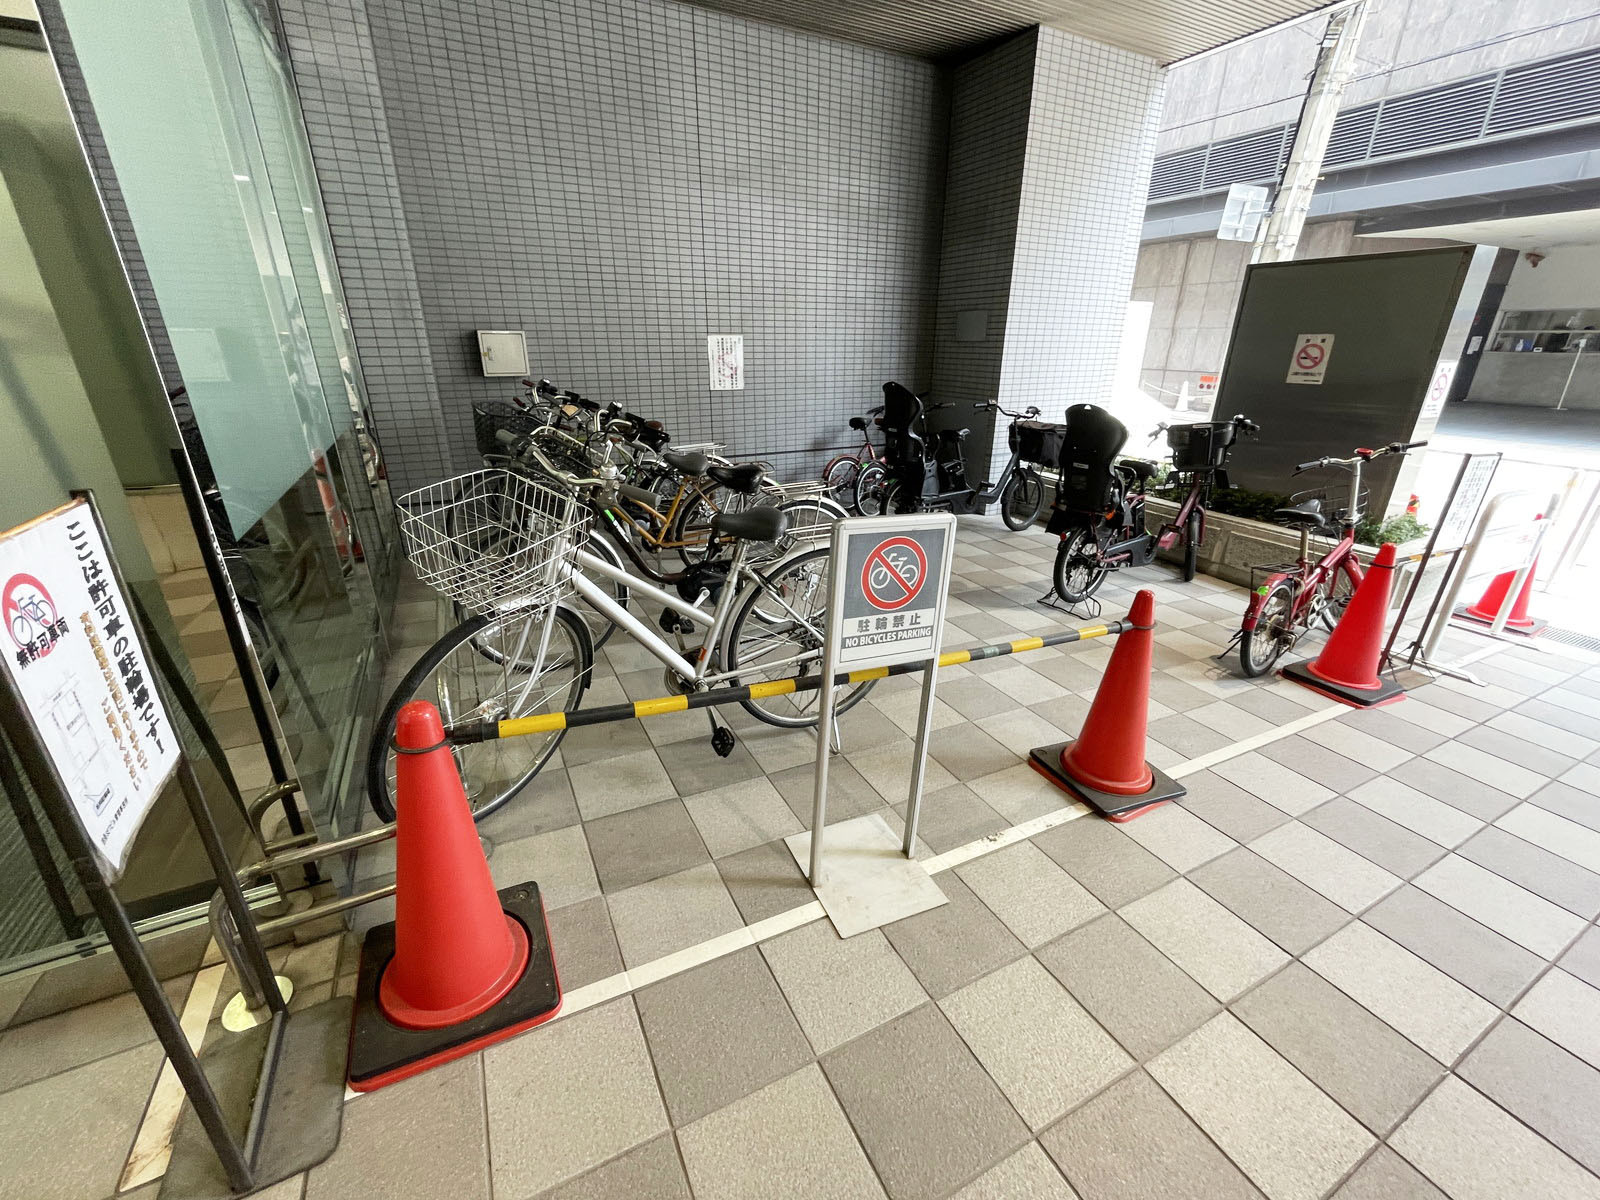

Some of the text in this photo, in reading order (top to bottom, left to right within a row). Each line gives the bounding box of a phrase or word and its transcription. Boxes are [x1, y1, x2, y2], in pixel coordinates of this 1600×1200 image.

[857, 613, 921, 632] 駐輪禁止
[16, 616, 71, 671] 無許可車両
[845, 627, 932, 648] NO BICYCLES PARKING
